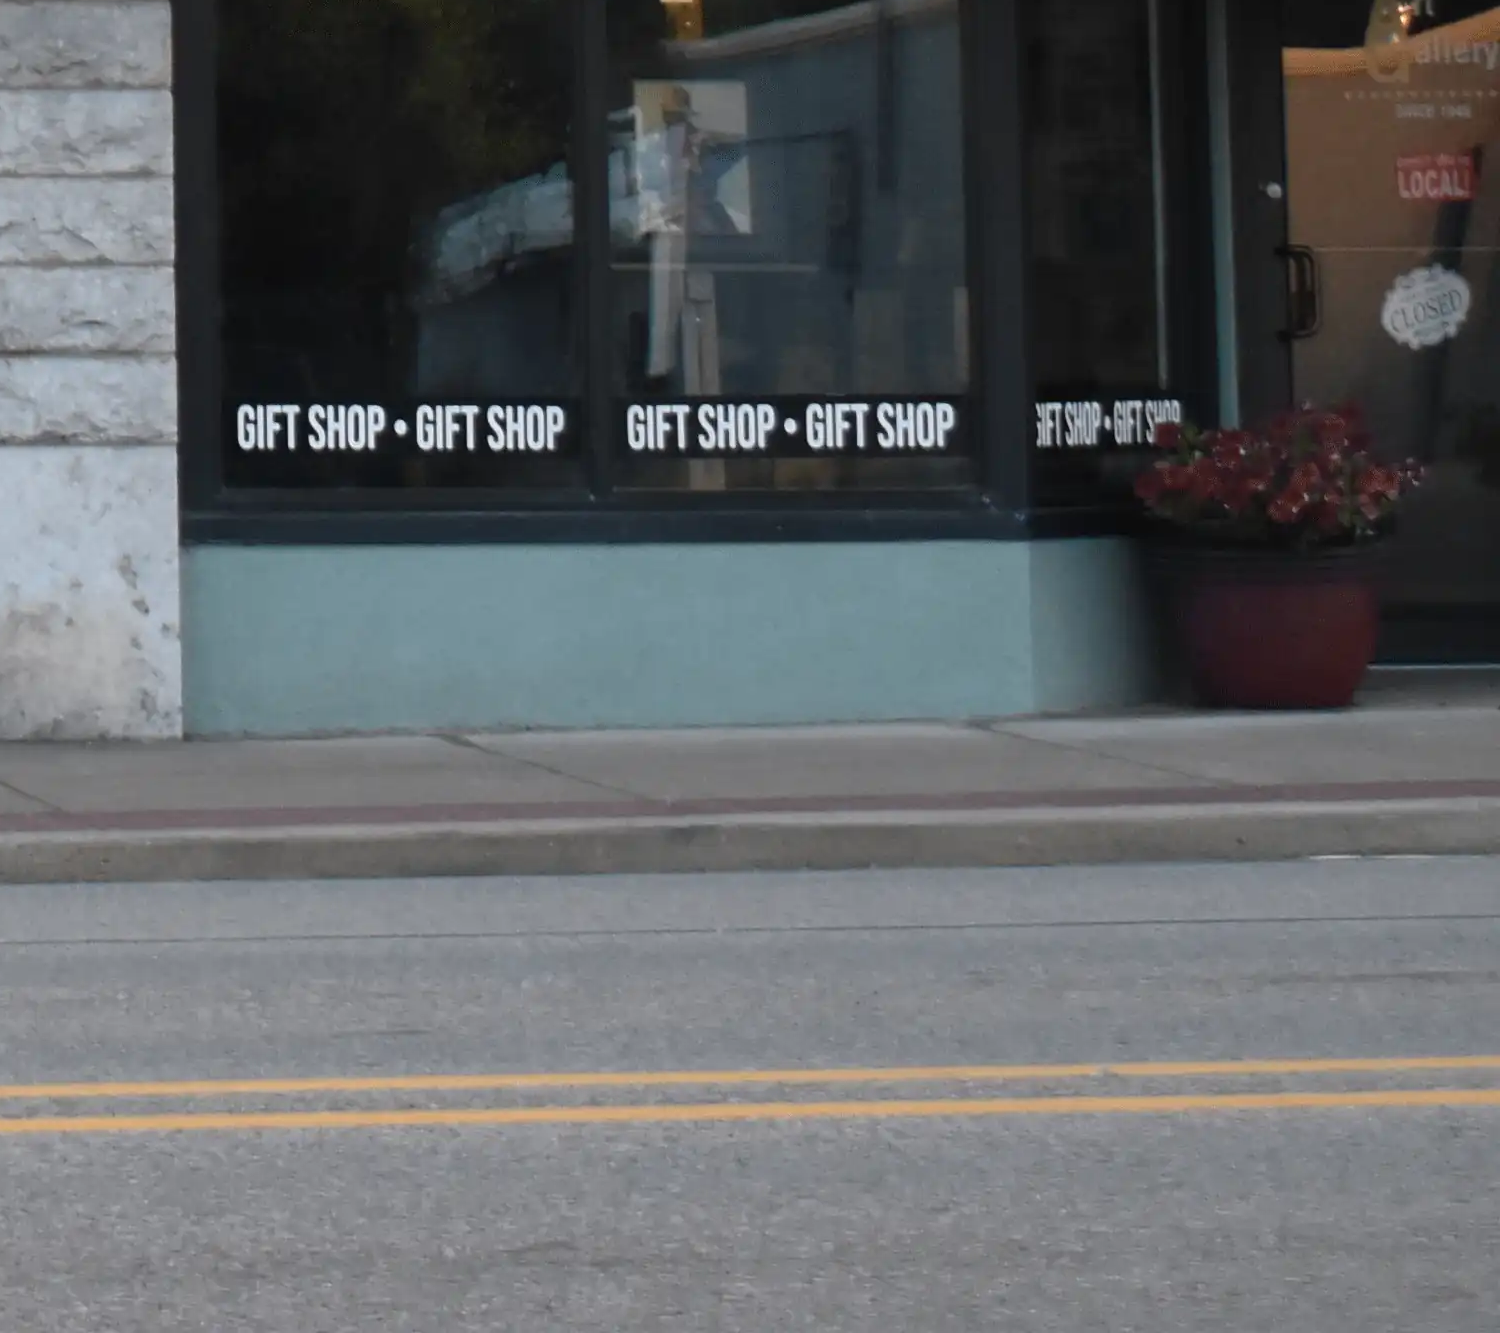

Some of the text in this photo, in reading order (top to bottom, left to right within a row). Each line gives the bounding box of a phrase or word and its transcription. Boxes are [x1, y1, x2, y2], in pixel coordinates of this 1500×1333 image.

[1397, 169, 1470, 199] LOCAL!
[1390, 289, 1463, 333] CLOSED
[237, 404, 565, 451] GIFT SHOP GIFT SHOP
[626, 403, 955, 450] GIFT SHOP GIFT SHOP
[1064, 401, 1102, 447] SHOP
[1113, 400, 1143, 445] GIFT
